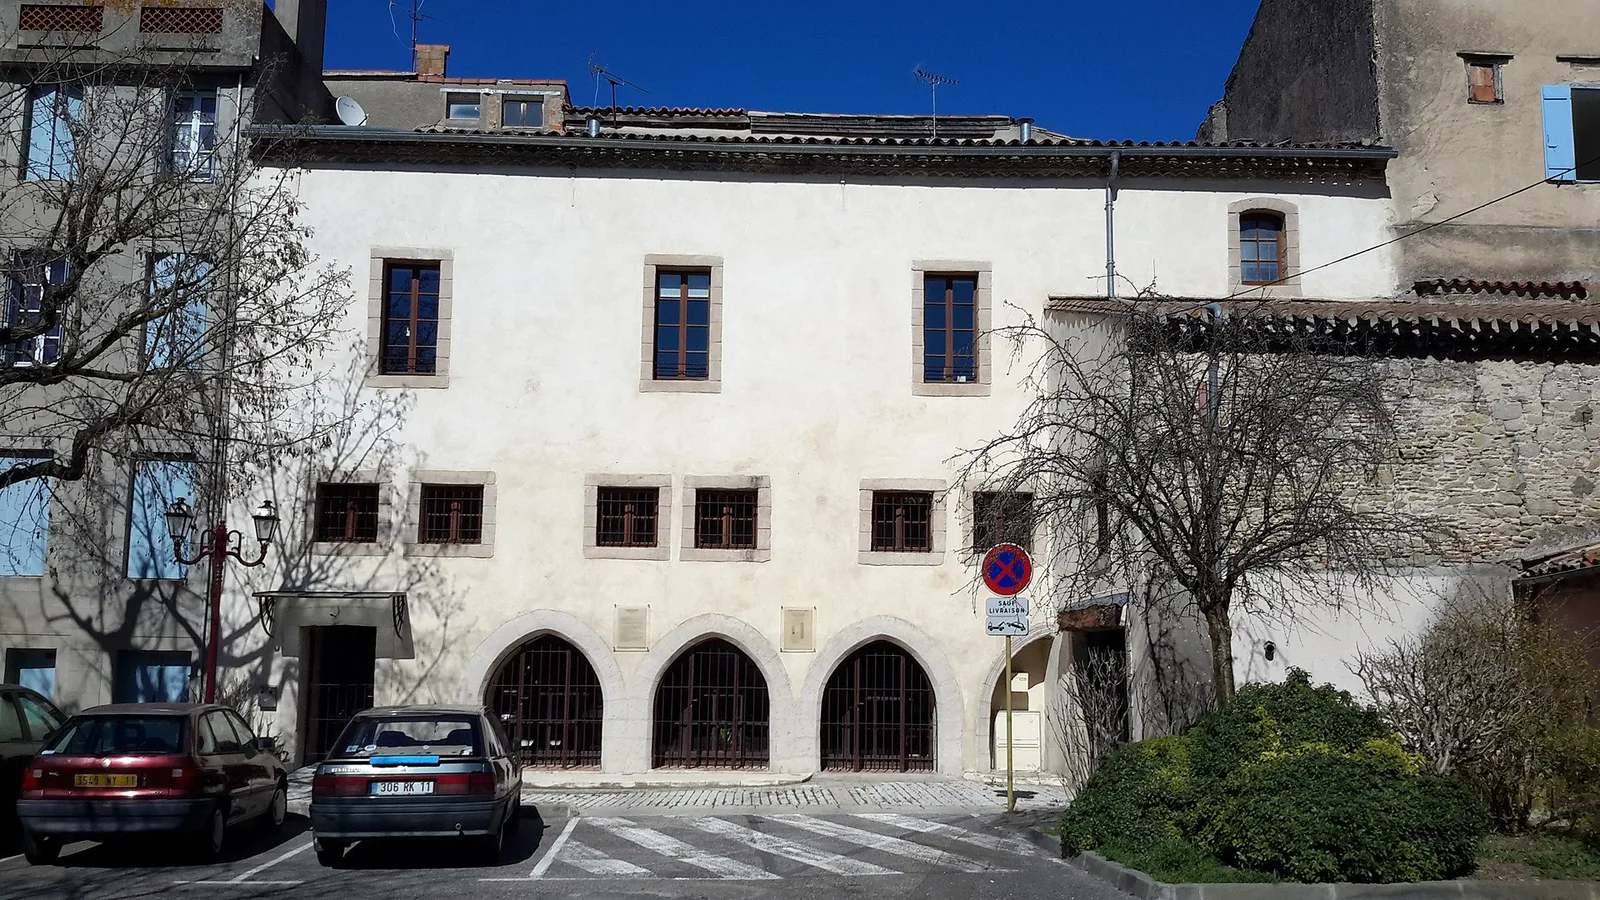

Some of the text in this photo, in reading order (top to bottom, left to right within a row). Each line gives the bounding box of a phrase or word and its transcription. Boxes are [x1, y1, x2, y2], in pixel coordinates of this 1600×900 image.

[125, 775, 135, 785] 11
[380, 781, 430, 792] 306 RK 11
